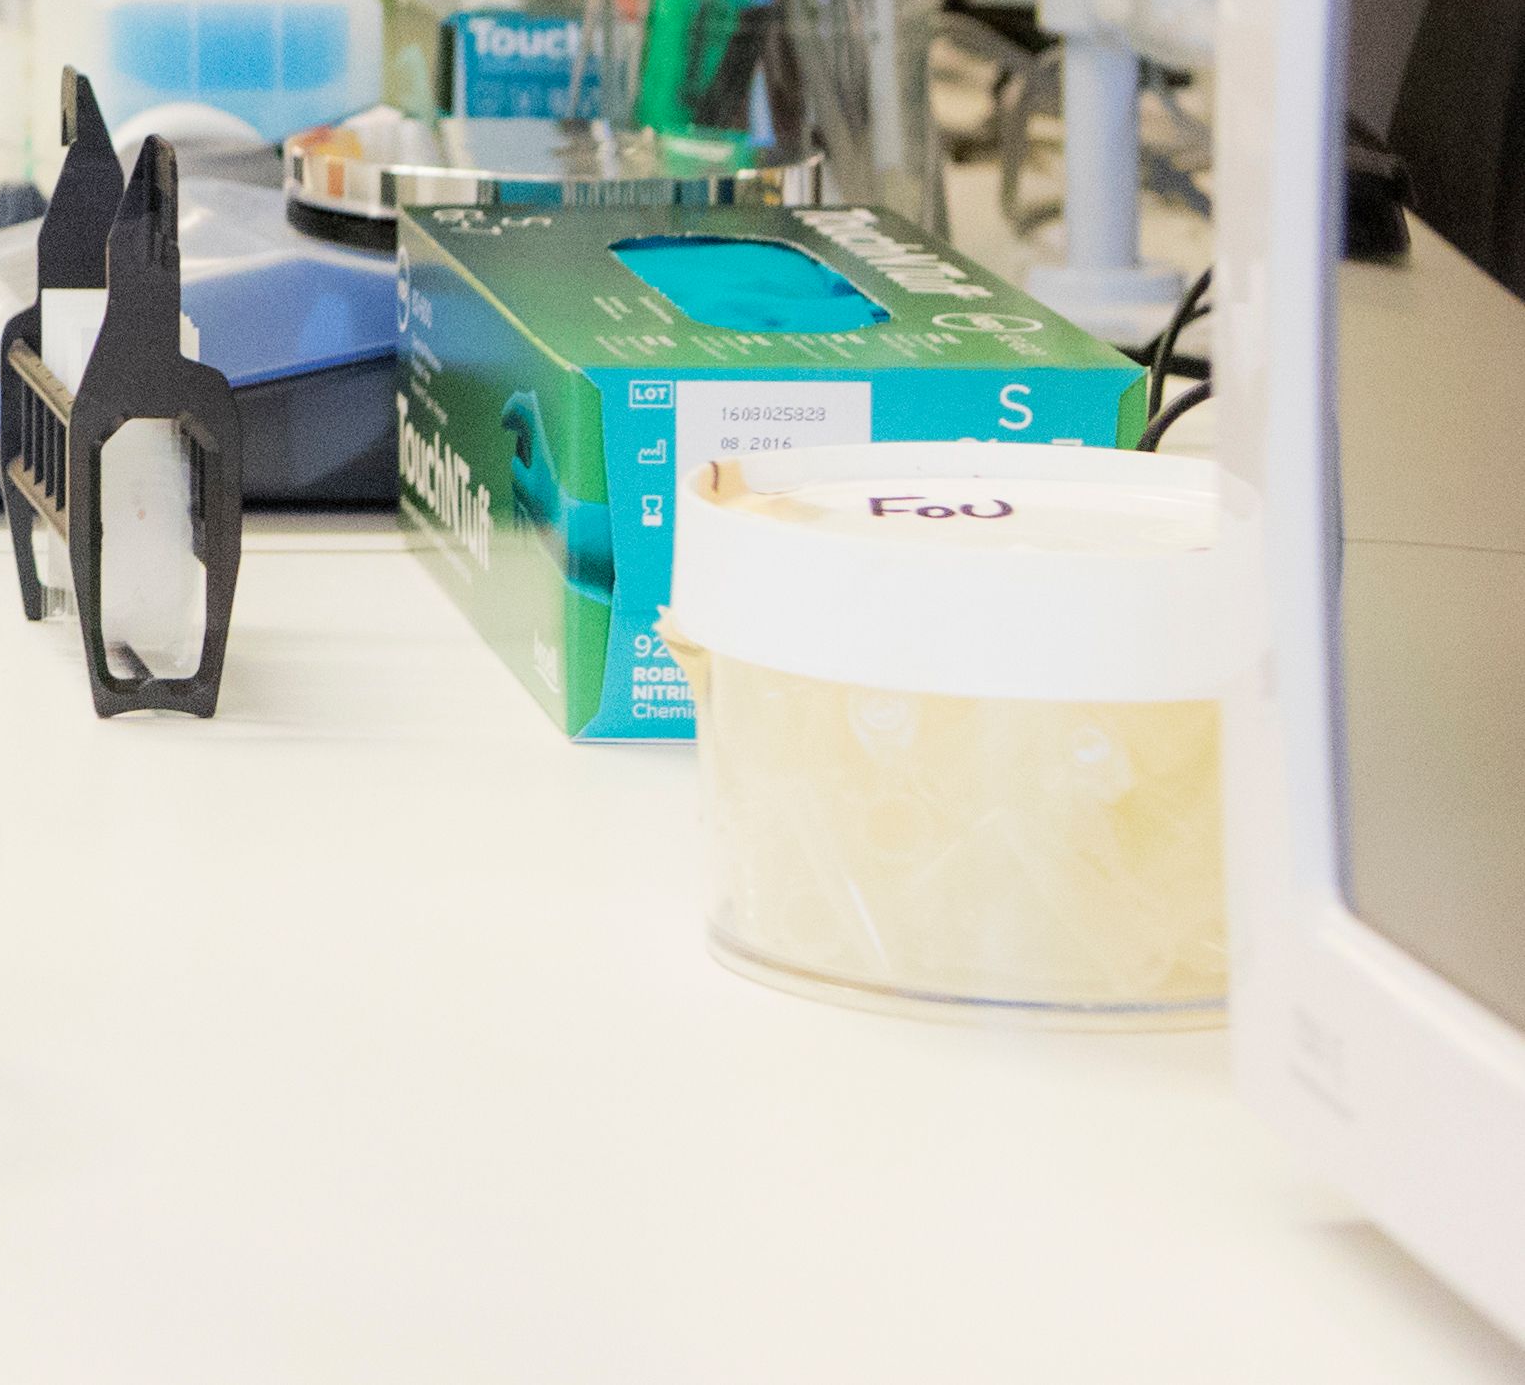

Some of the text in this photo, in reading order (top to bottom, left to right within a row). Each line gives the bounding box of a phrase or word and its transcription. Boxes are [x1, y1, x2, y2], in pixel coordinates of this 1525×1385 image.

[634, 387, 668, 401] LOT
[998, 383, 1034, 431] S
[720, 436, 793, 451] 08.2016
[396, 391, 491, 571] TouchNTuff
